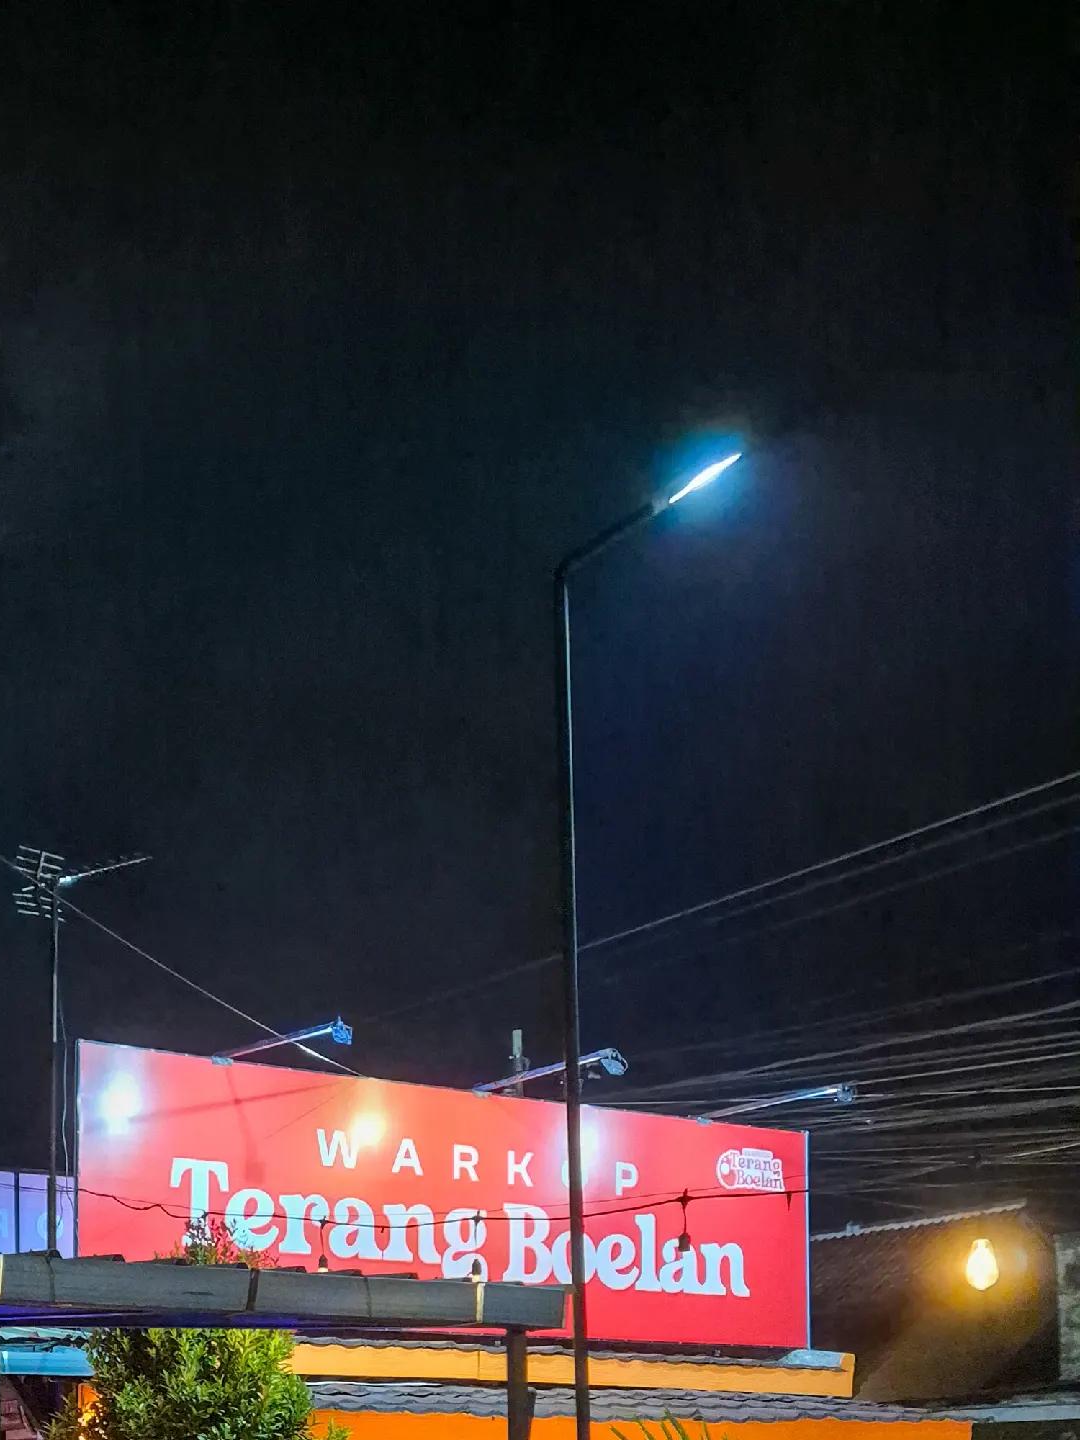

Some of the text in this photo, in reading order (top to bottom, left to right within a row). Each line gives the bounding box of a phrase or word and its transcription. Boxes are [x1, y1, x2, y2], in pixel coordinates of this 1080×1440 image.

[730, 1152, 781, 1177] Terang
[736, 1169, 783, 1190] Boelan
[170, 1157, 751, 1297] Terang Boelan
